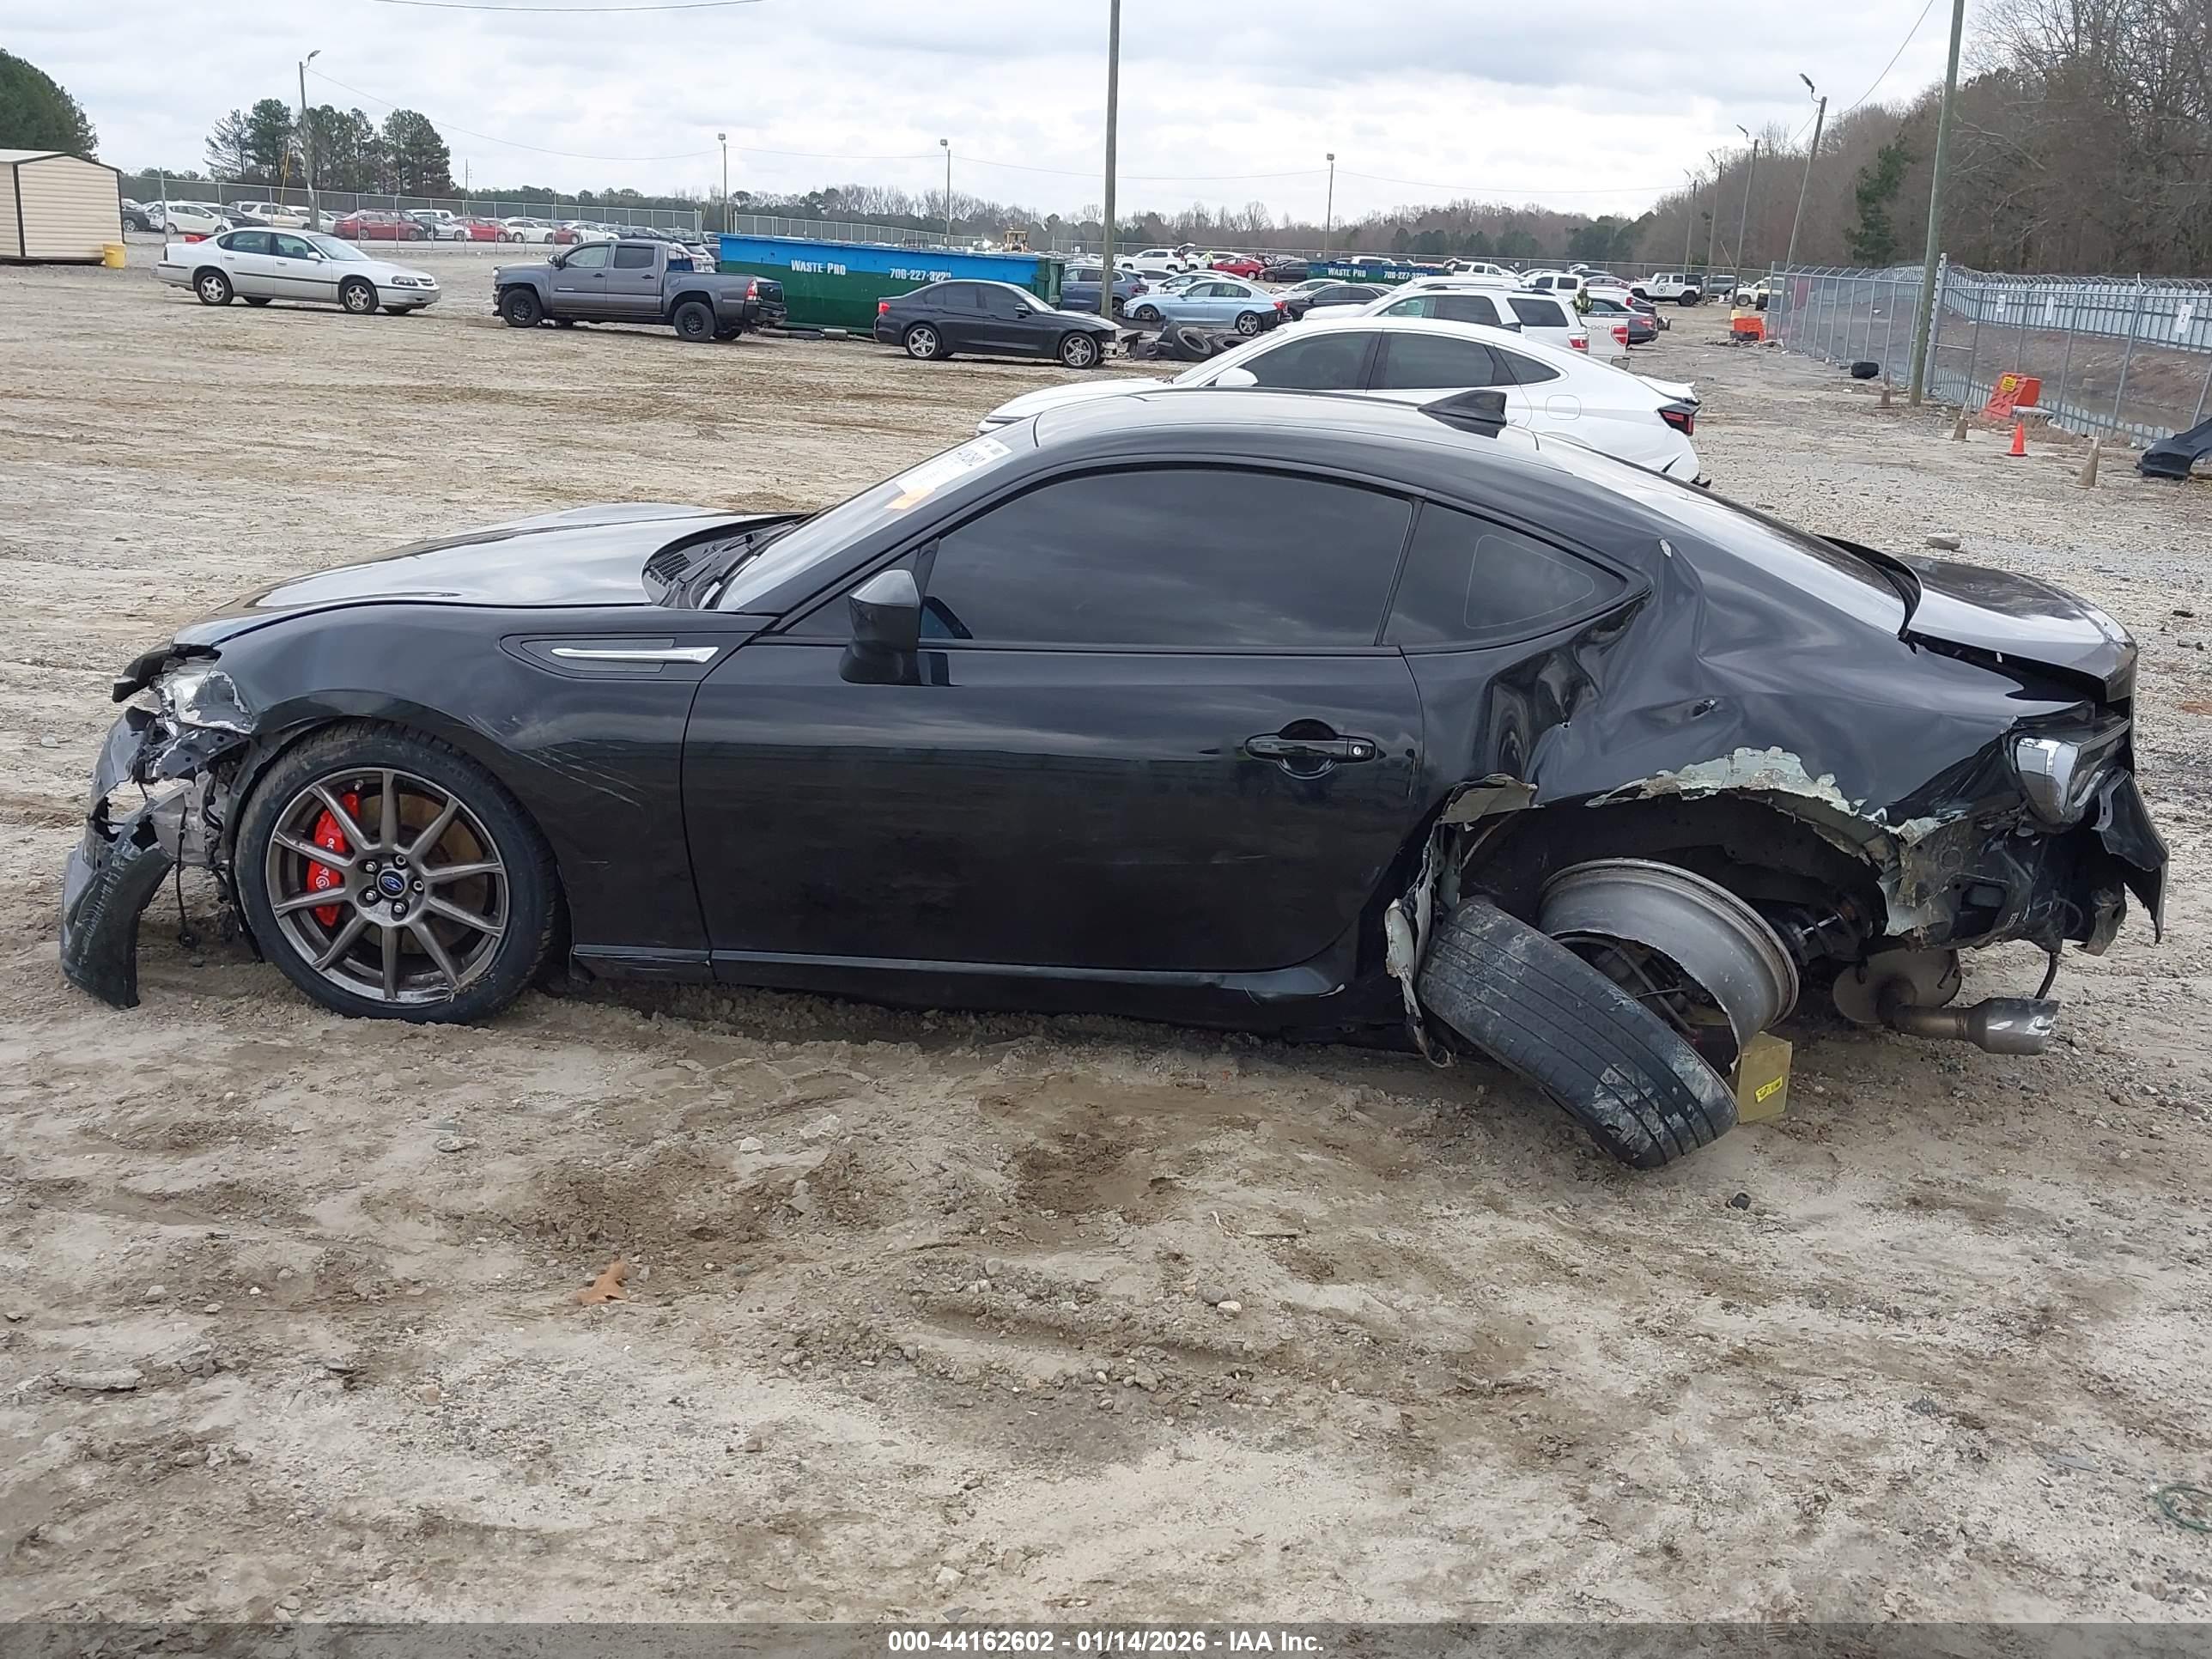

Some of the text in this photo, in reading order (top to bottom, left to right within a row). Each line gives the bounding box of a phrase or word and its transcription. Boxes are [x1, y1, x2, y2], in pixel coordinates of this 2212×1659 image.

[791, 259, 847, 276] WASTE PRO
[1328, 267, 1367, 278] WASTE PRO
